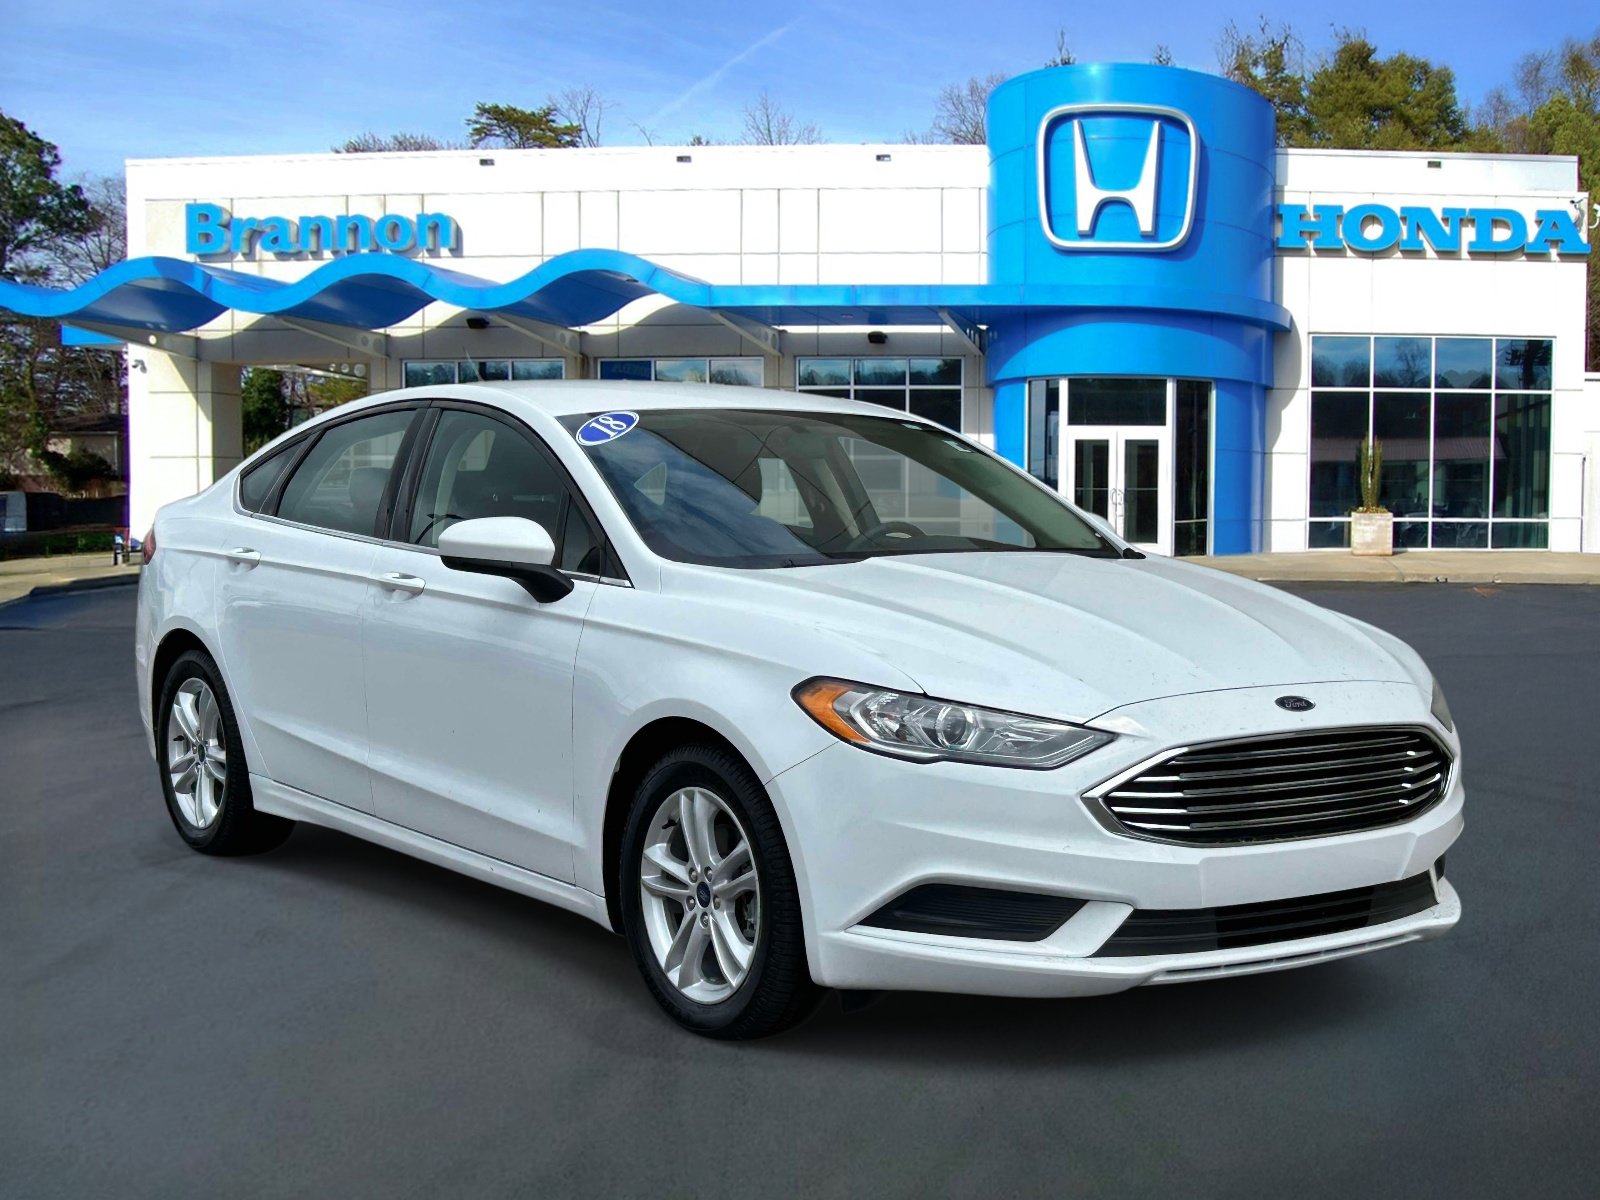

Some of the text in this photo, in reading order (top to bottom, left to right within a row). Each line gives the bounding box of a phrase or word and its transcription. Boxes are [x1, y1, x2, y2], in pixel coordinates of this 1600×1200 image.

[1072, 119, 1160, 236] H
[185, 202, 457, 255] Brannon
[1276, 203, 1592, 254] HONDA
[589, 416, 627, 438] 18
